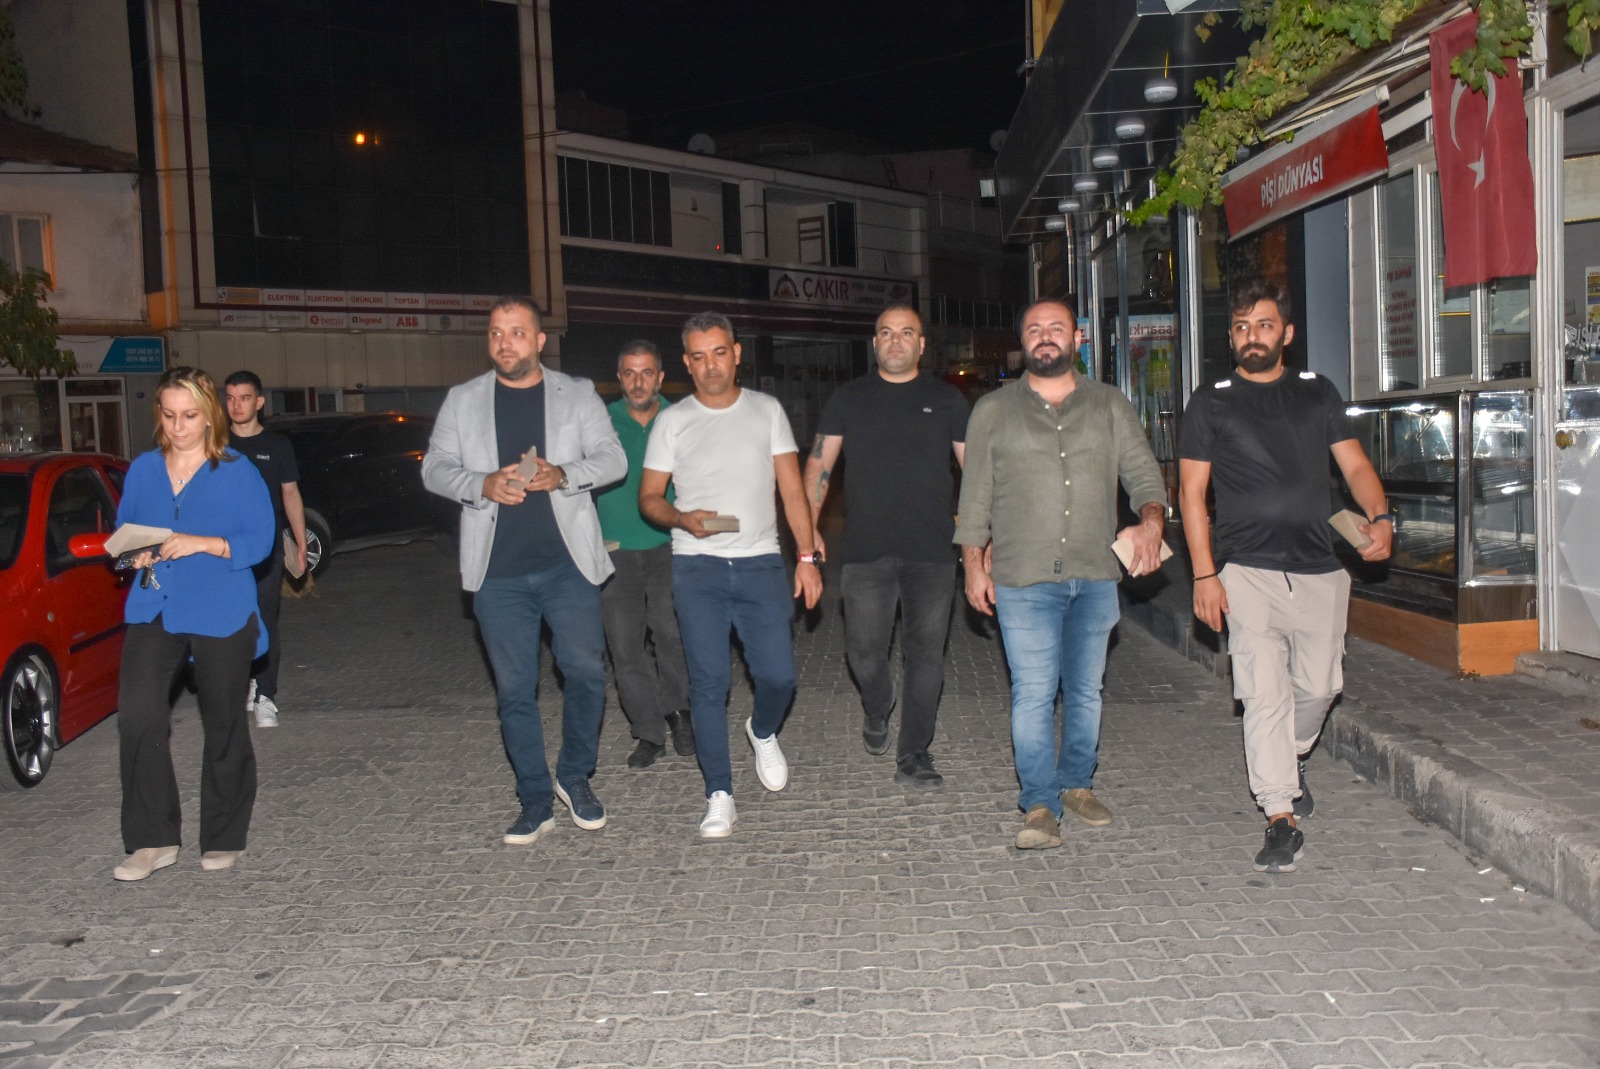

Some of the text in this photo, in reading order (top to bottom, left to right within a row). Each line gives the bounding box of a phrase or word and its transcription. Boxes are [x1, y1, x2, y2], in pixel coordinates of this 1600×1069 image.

[1260, 154, 1324, 208] PİŞİ DÜNYASI
[802, 277, 850, 302] ÇAKIR
[320, 315, 345, 325] bemis
[396, 316, 419, 327] ABB
